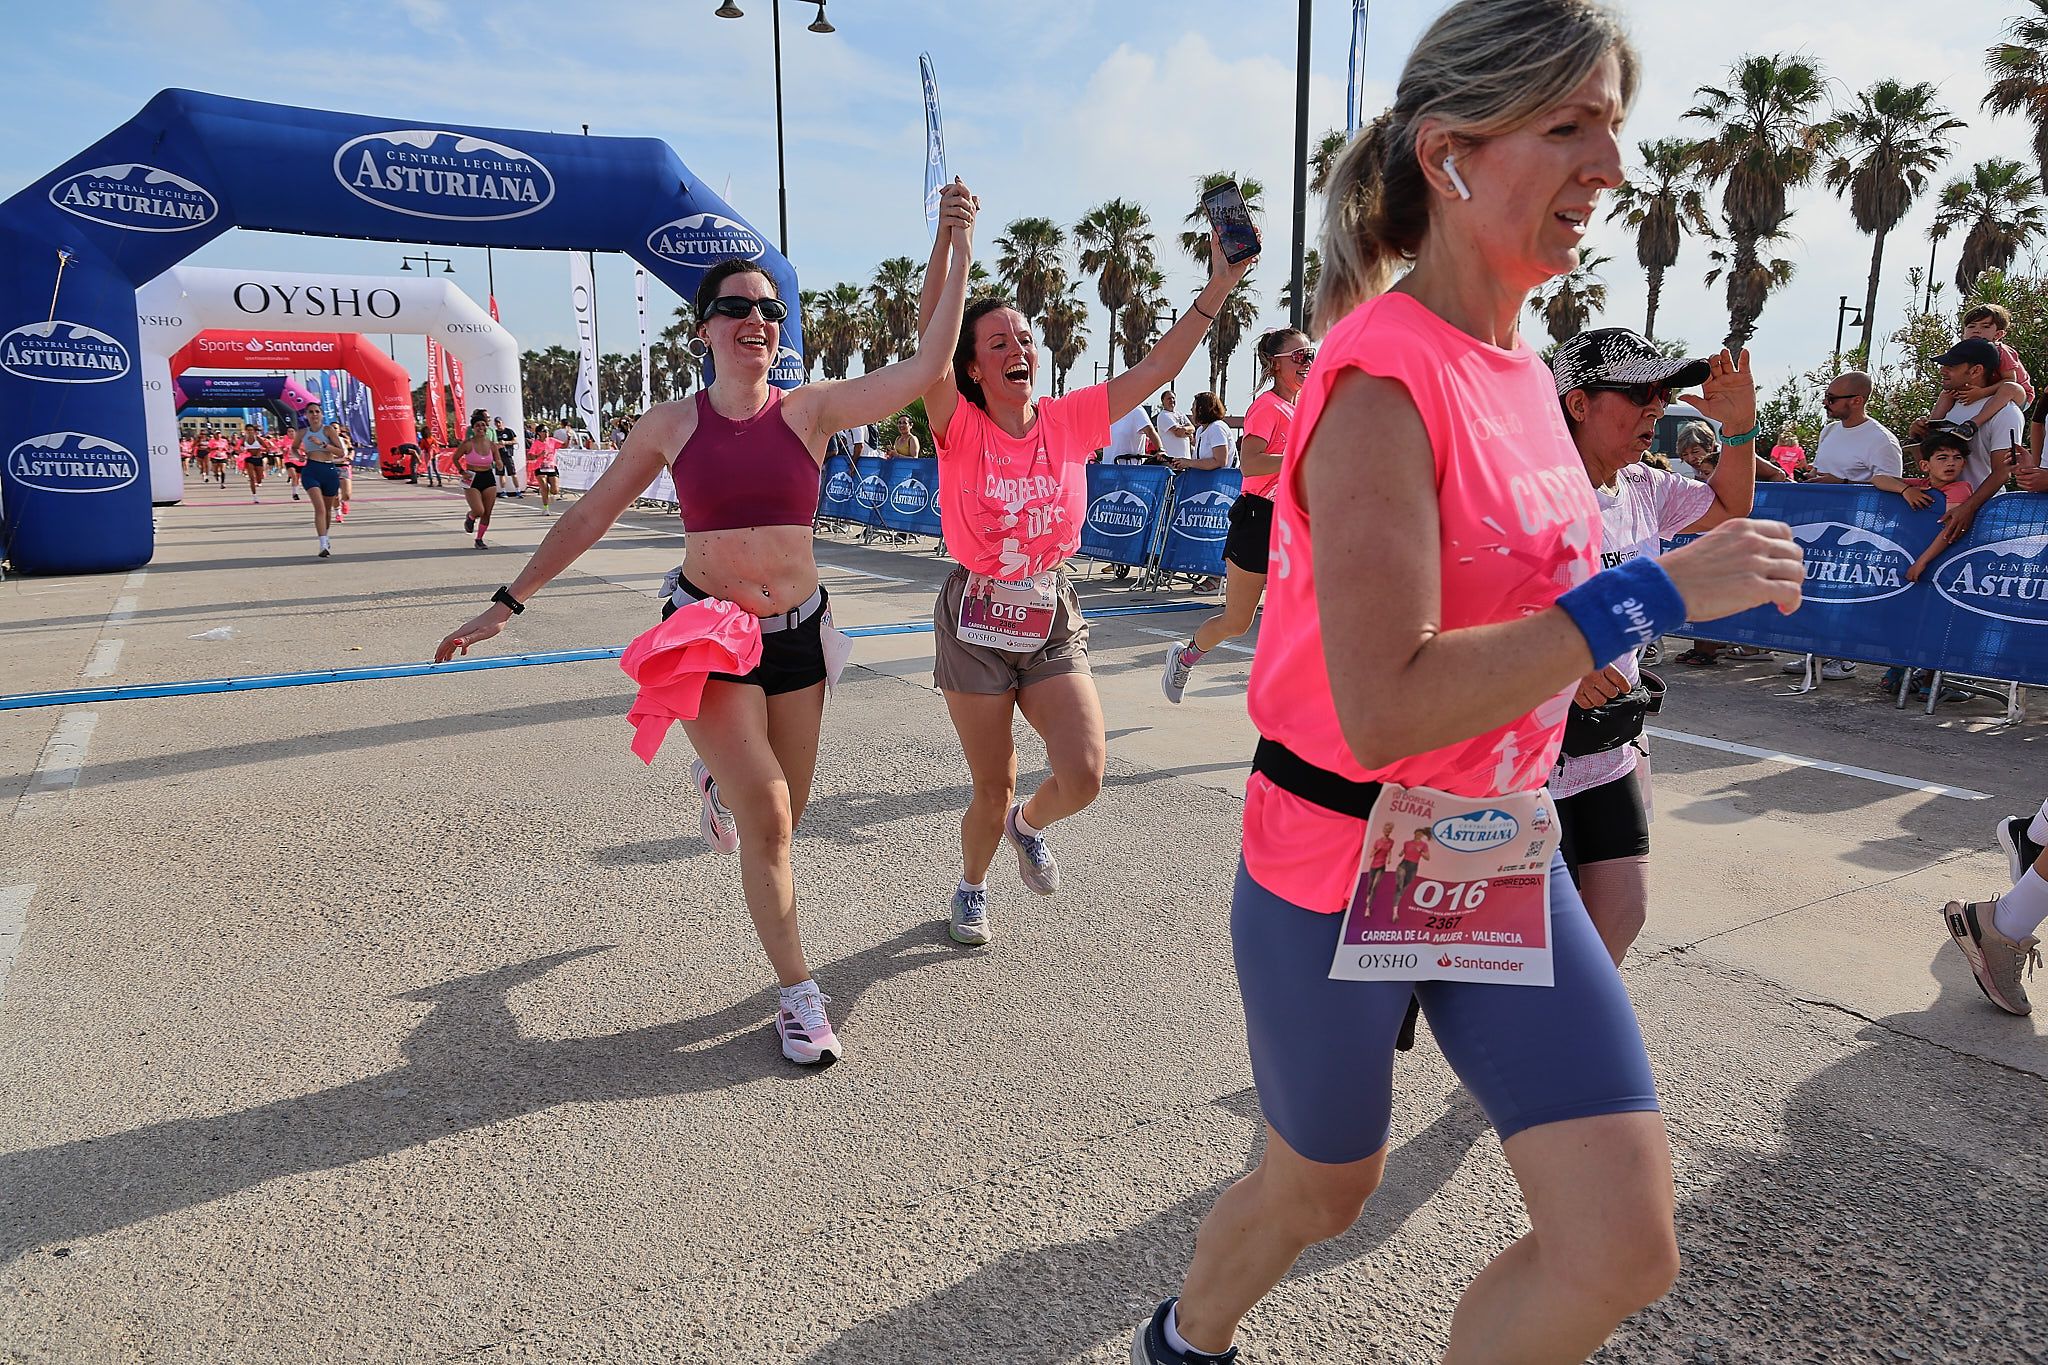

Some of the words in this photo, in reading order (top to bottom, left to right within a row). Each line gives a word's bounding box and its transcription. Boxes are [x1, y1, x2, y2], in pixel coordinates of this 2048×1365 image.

[387, 149, 457, 168] CENTRAL
[463, 158, 532, 175] LECHERA
[353, 149, 540, 204] ASTURIANA
[88, 180, 146, 195] CENTRAL
[149, 187, 204, 203] LECHERA
[61, 182, 206, 222] ASTURIANA
[657, 233, 760, 256] ASTURIANA
[233, 281, 401, 319] OYSHO
[138, 315, 183, 328] YSHO
[447, 323, 492, 334] OYSHO
[21, 340, 71, 350] CENTRAL
[73, 342, 119, 354] LECHERA
[198, 338, 245, 354] Sports
[264, 340, 335, 353] Santander
[5, 341, 124, 372] ASTURIANA
[475, 384, 516, 394] OYSHO
[32, 451, 81, 460] CENTRAL
[83, 451, 128, 461] LECHERA
[16, 453, 133, 479] ASTURIANA
[1090, 504, 1144, 528] ASTURIANA
[1174, 508, 1231, 530] ASTURIAN
[1807, 547, 1834, 558] TRAL
[1838, 551, 1899, 564] LECHERA
[1803, 560, 1902, 588] URIANA
[991, 602, 1027, 621] 016
[968, 622, 988, 631] CARRERA
[1000, 620, 1017, 629] 2366
[967, 632, 997, 642] OYSHO
[1013, 641, 1039, 649] Santander
[1389, 800, 1433, 820] SUMA
[1438, 823, 1512, 842] ASTURIANA
[1493, 877, 1541, 888] CORREDORA
[1413, 879, 1489, 911] 016
[1425, 916, 1463, 930] 2367
[1361, 930, 1402, 942] CARRERA
[1404, 930, 1417, 941] DE
[1417, 930, 1430, 941] LA
[1432, 931, 1463, 943] MUJER
[1471, 932, 1523, 944] VALENCIA
[1358, 953, 1418, 970] OYSHO
[1454, 955, 1525, 972] Santander
